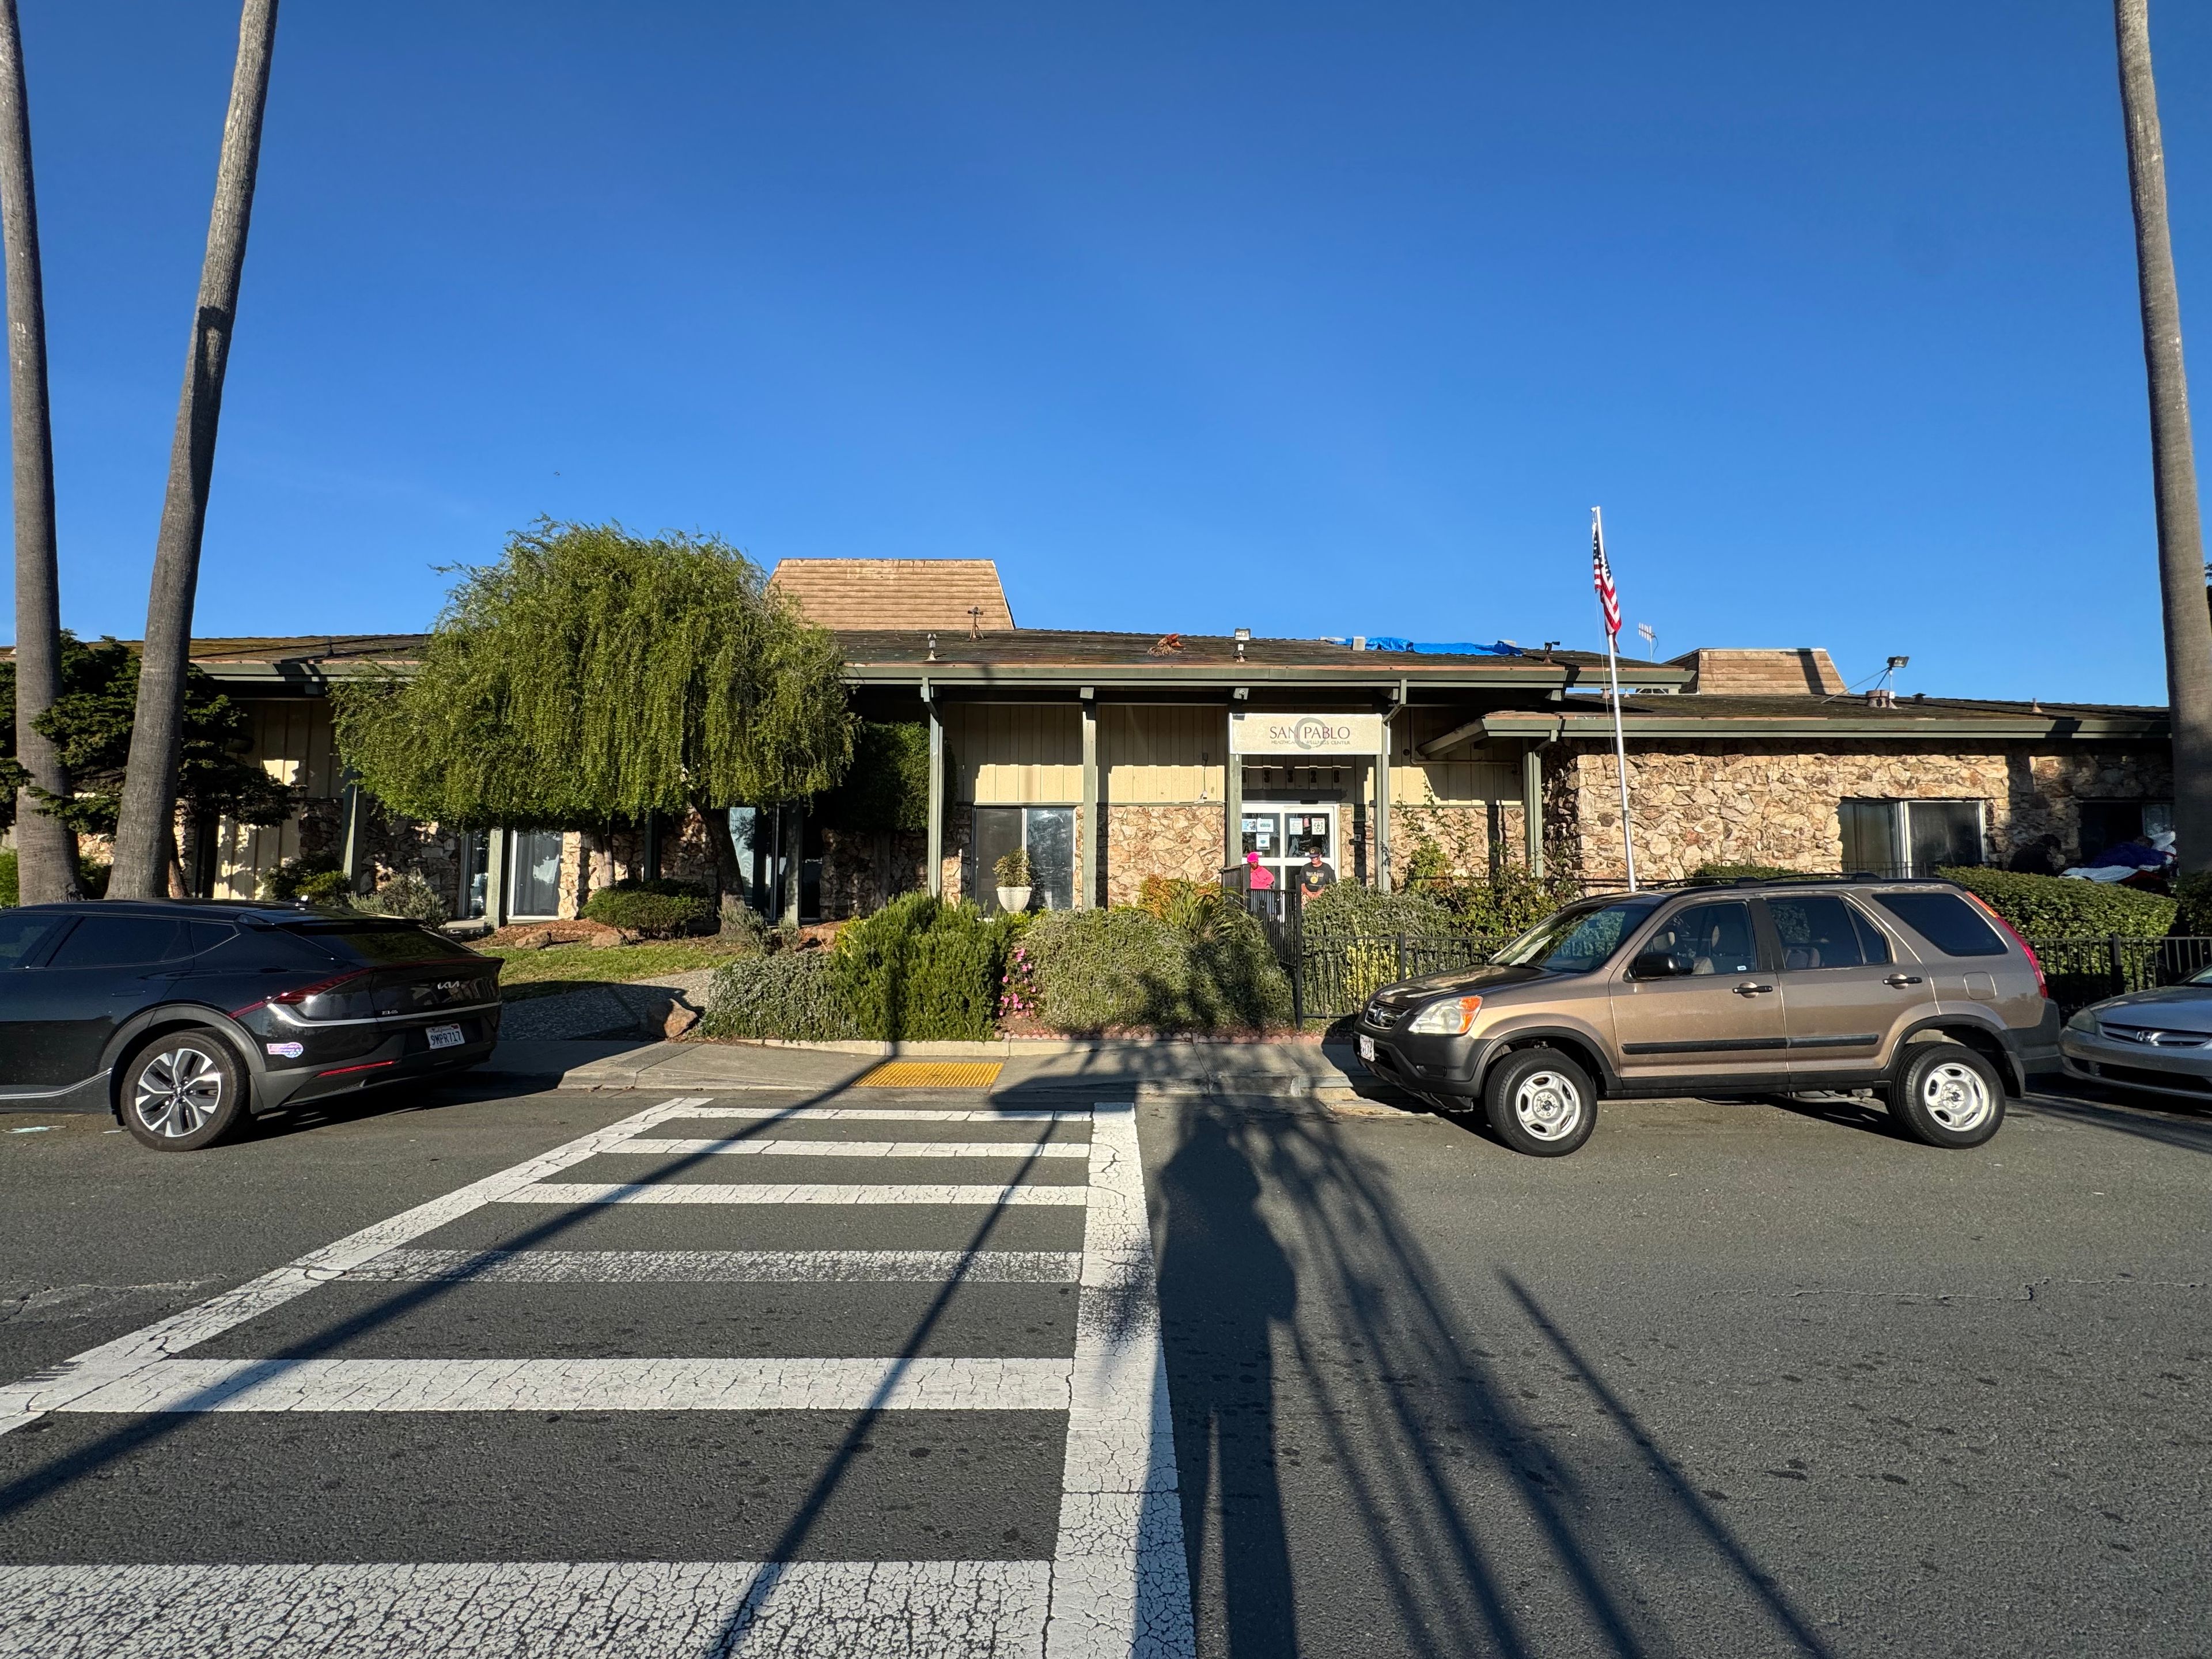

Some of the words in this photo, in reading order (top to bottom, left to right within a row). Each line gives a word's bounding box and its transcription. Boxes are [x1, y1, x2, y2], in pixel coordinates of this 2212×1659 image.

[1270, 726, 1299, 739] SAN
[1304, 726, 1351, 739] PABLO
[430, 1031, 461, 1046] 9MPR717
